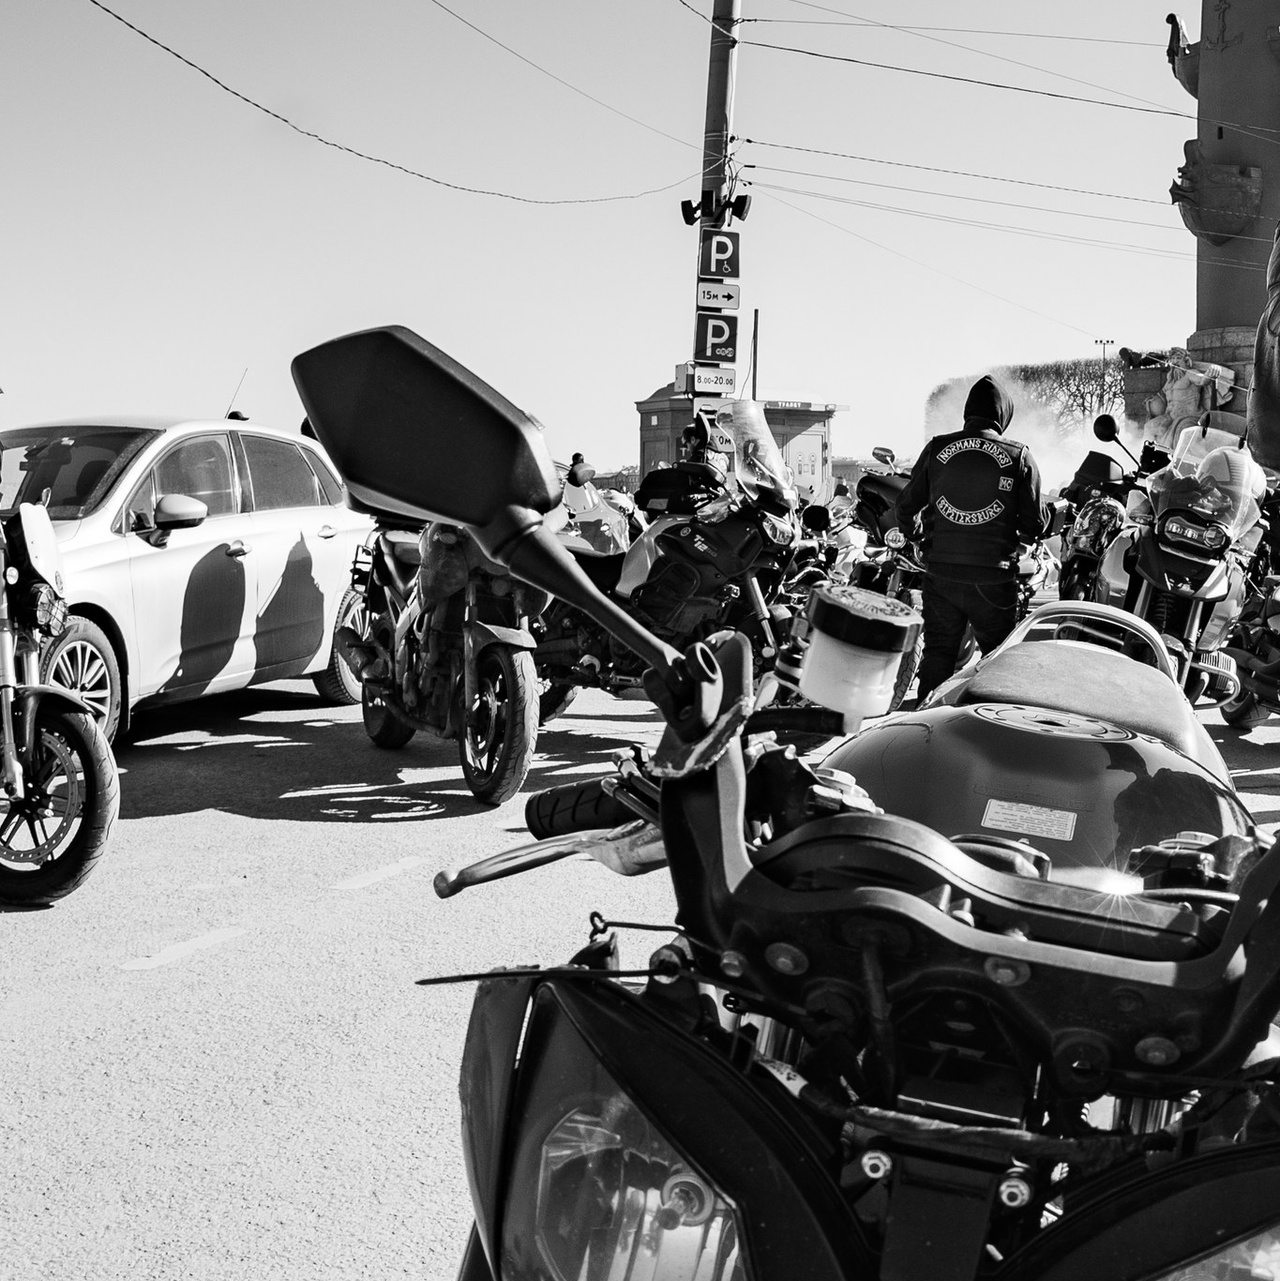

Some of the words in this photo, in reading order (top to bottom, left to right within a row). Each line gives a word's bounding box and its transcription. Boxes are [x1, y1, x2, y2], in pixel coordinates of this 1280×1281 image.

[711, 235, 734, 272] P
[706, 318, 730, 357] P
[939, 439, 982, 461] NORMANS
[982, 441, 1009, 465] RIDERS
